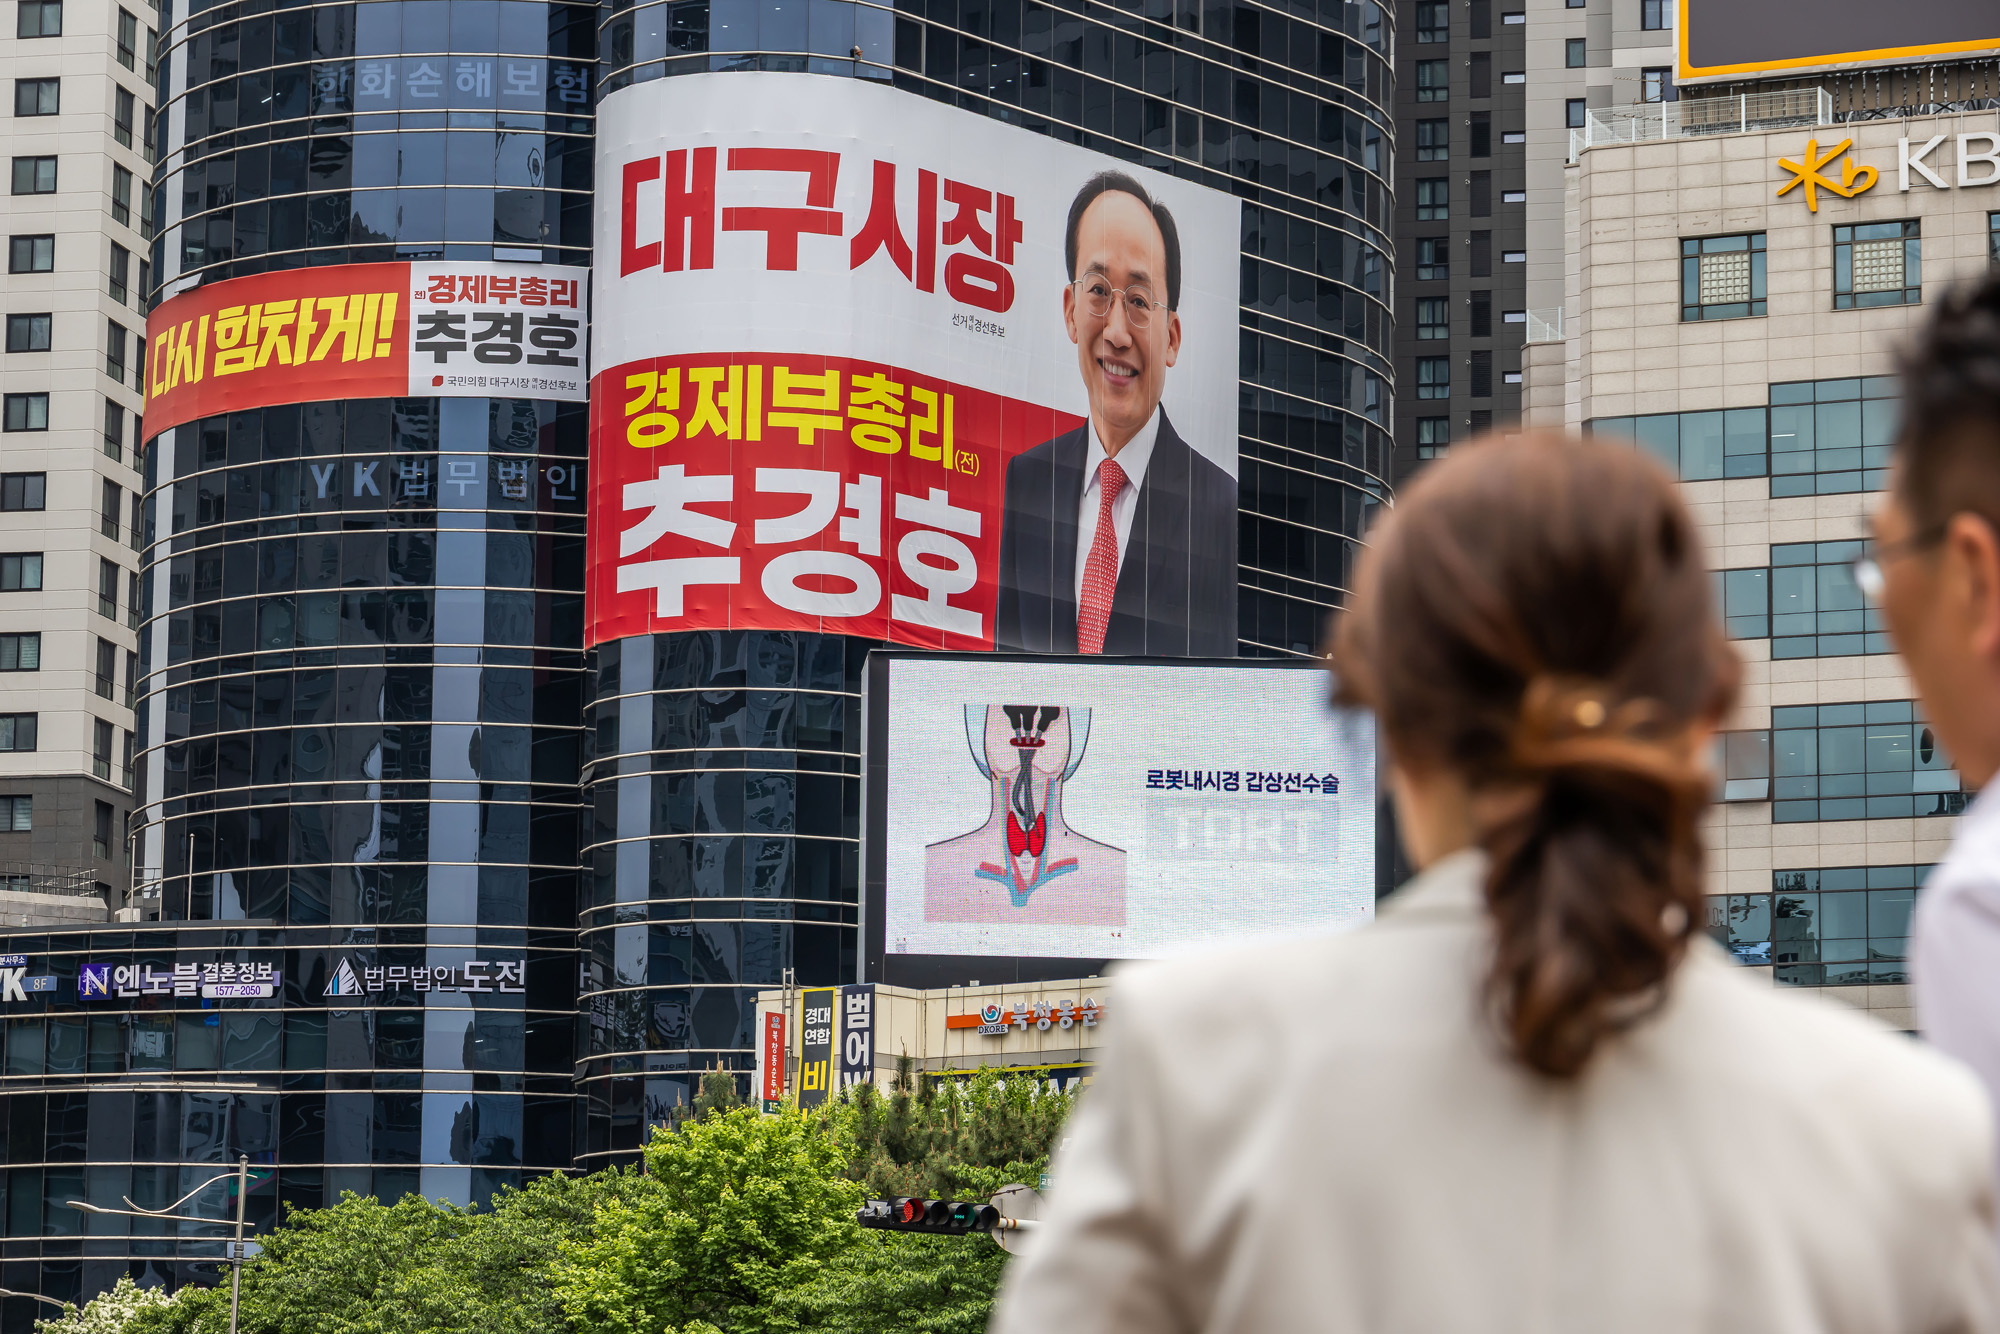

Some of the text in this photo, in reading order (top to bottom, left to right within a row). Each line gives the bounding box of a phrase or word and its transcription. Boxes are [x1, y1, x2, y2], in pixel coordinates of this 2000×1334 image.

[316, 61, 589, 104] 한화손해보험
[1898, 131, 2000, 192] KB
[620, 147, 1023, 313] 대구시장
[427, 275, 578, 309] 경제부총리
[151, 314, 211, 400] 다시
[213, 292, 399, 378] 힘차게!
[415, 310, 579, 367] 추경호
[447, 376, 487, 387] 국민의힘
[489, 377, 530, 389] 대구시장
[624, 364, 980, 477] 경제부총리 (전)
[310, 458, 577, 501] YK 법무법인
[616, 463, 985, 639] 추경호
[1145, 769, 1340, 794] 로봇내시경 갑상선수술
[0, 967, 28, 1002] K
[33, 978, 47, 990] 8F
[113, 962, 200, 998] 엔노블
[202, 962, 274, 983] 결혼정보
[364, 959, 526, 994] 법무법인 도전
[214, 985, 261, 996] 1577-2050
[805, 1006, 831, 1025] 경대
[978, 1026, 1006, 1035] DKORE
[804, 1028, 830, 1046] 연합
